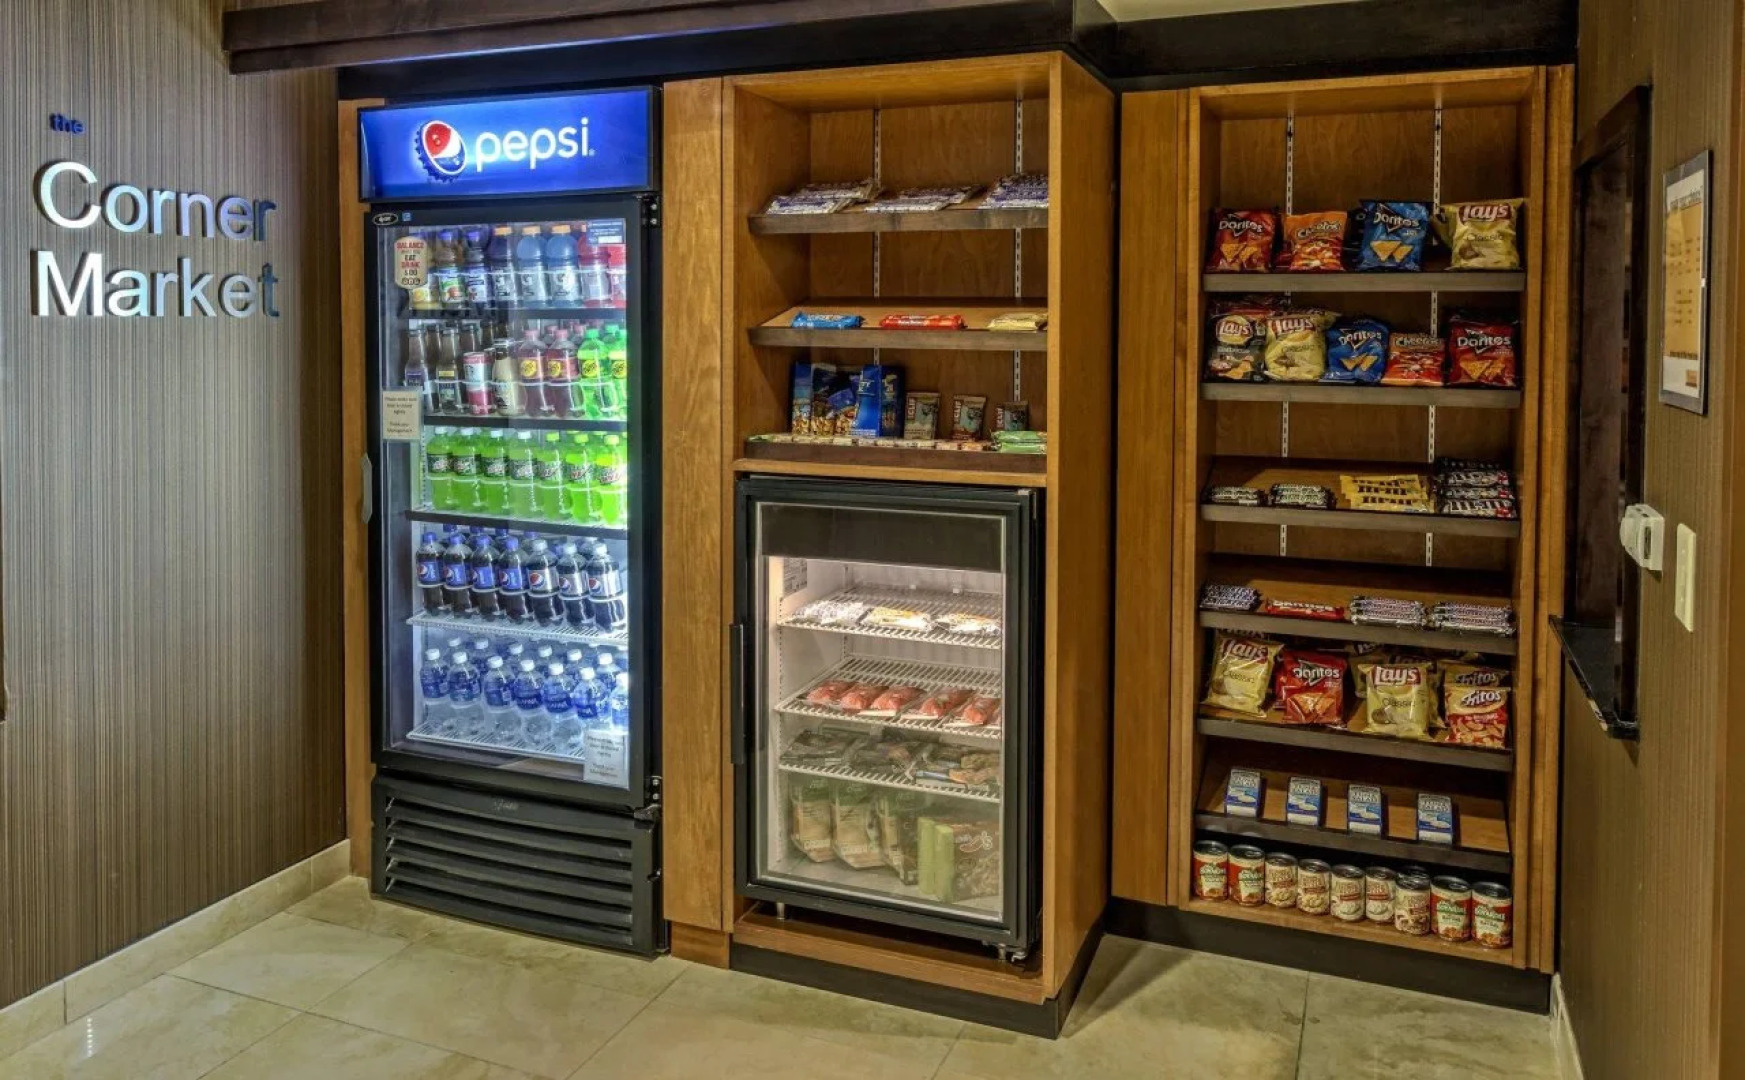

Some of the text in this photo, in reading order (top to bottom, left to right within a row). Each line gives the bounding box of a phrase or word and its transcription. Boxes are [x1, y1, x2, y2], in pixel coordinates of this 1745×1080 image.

[50, 113, 84, 135] the
[475, 117, 589, 173] pepsi
[33, 161, 277, 241] Corner
[30, 249, 279, 318] Market
[1457, 335, 1512, 347] Doritos
[1293, 667, 1340, 680] Doritos
